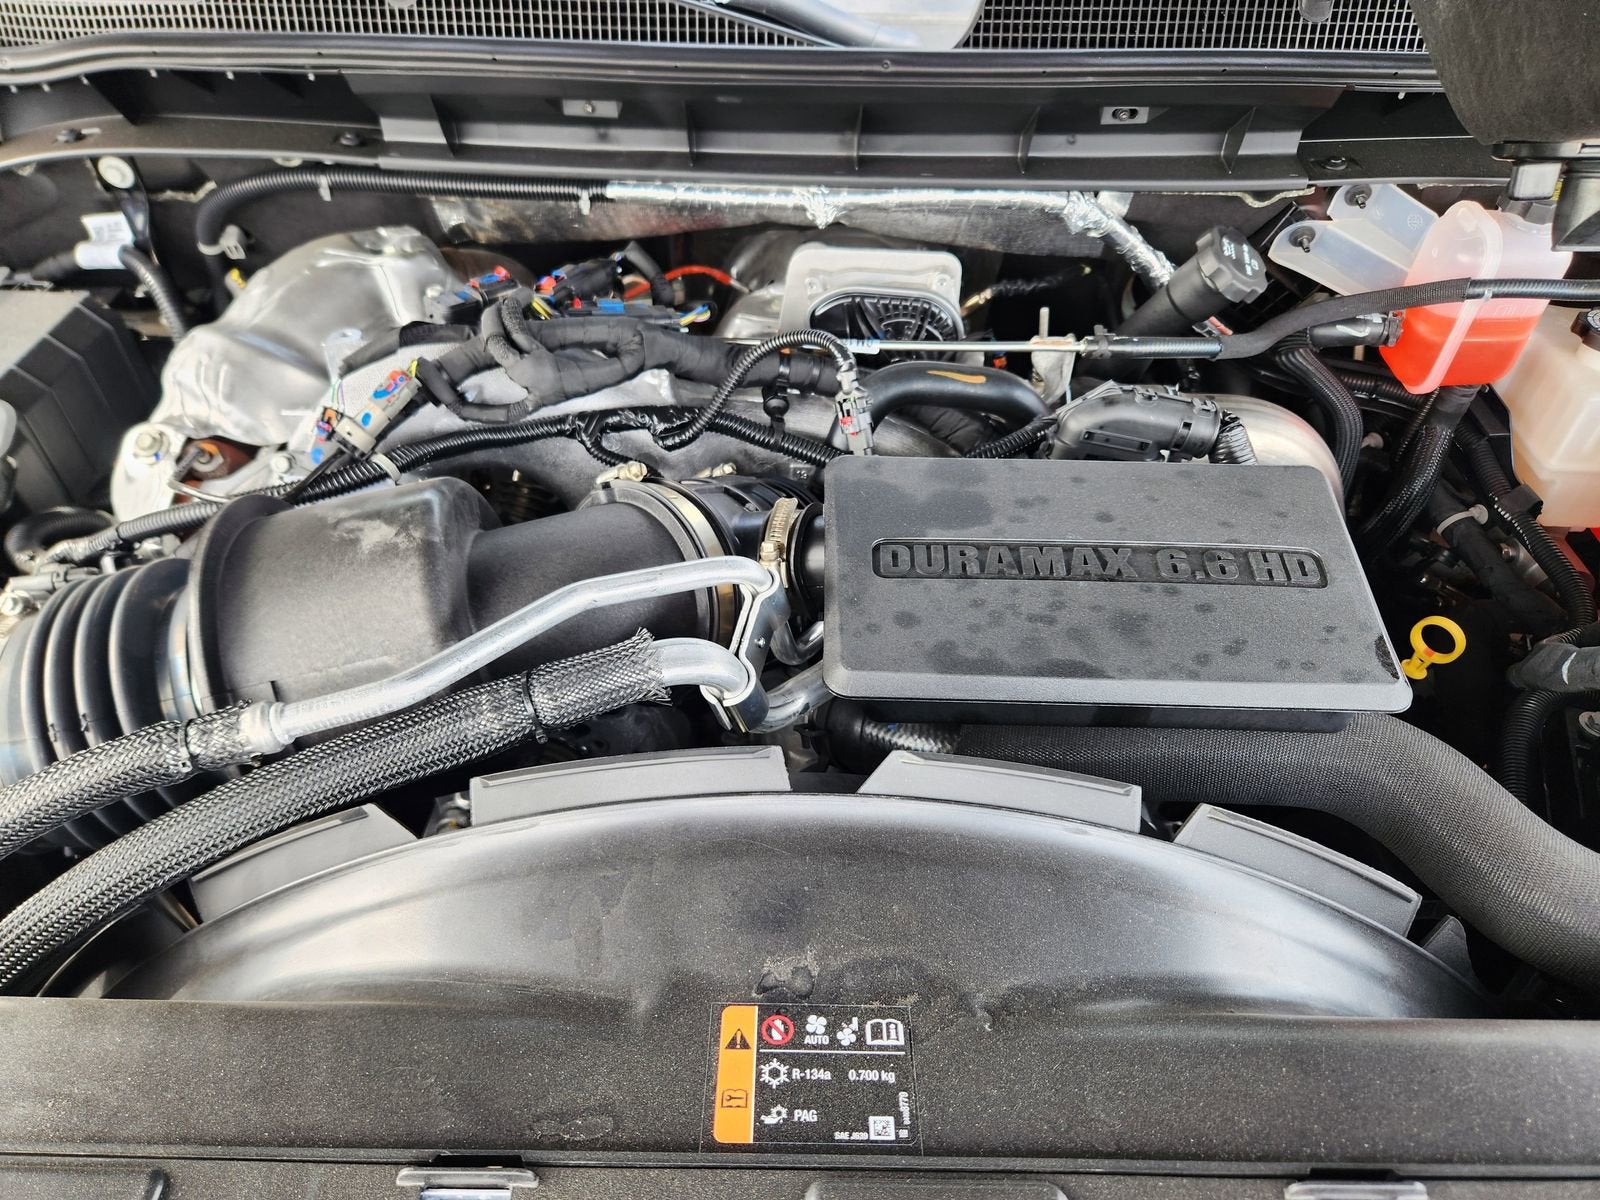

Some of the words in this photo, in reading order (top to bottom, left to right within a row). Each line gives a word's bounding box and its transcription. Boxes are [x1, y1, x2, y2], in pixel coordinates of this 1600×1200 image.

[879, 543, 1137, 577] DURAMAX
[1155, 548, 1240, 581] 6.6
[1248, 551, 1322, 583] HD
[804, 1034, 830, 1046] AUTO
[791, 1068, 832, 1081] R-134a
[848, 1069, 879, 1081] 0.700
[880, 1069, 896, 1084] kg
[794, 1109, 818, 1122] PAG
[834, 1131, 850, 1140] SAE
